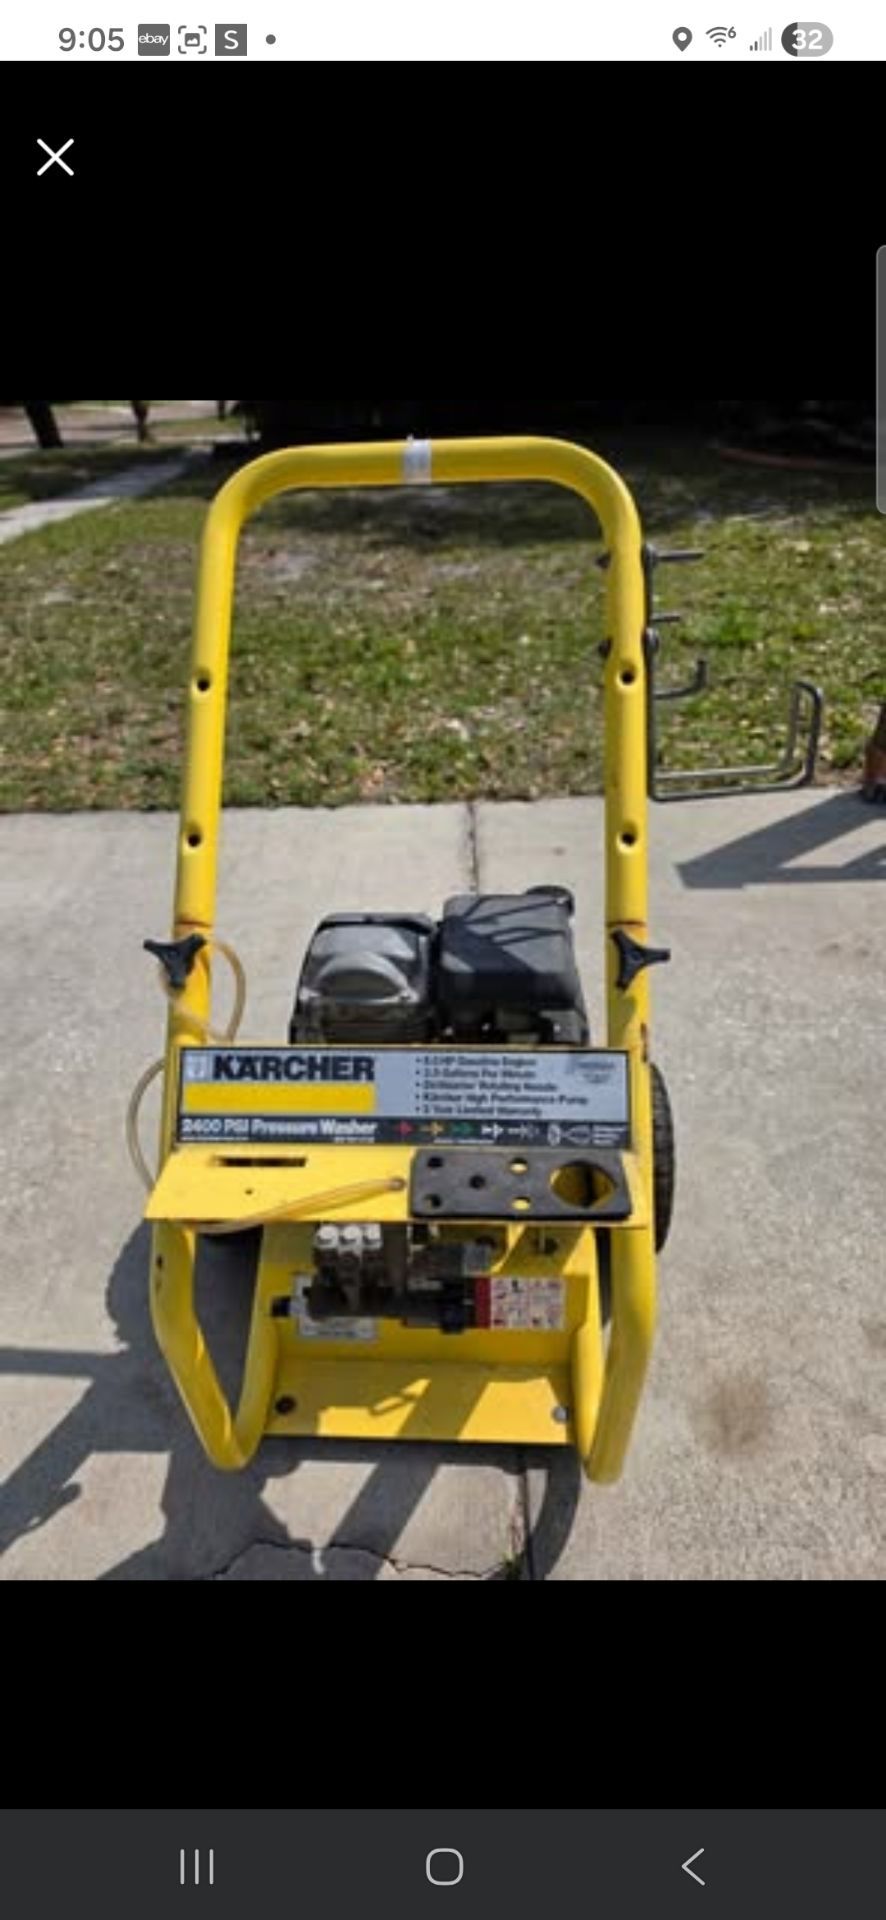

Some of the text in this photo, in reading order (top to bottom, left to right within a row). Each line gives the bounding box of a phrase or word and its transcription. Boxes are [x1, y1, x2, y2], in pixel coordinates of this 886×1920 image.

[181, 1118, 377, 1136] 2400 PSI Pressure Washer
